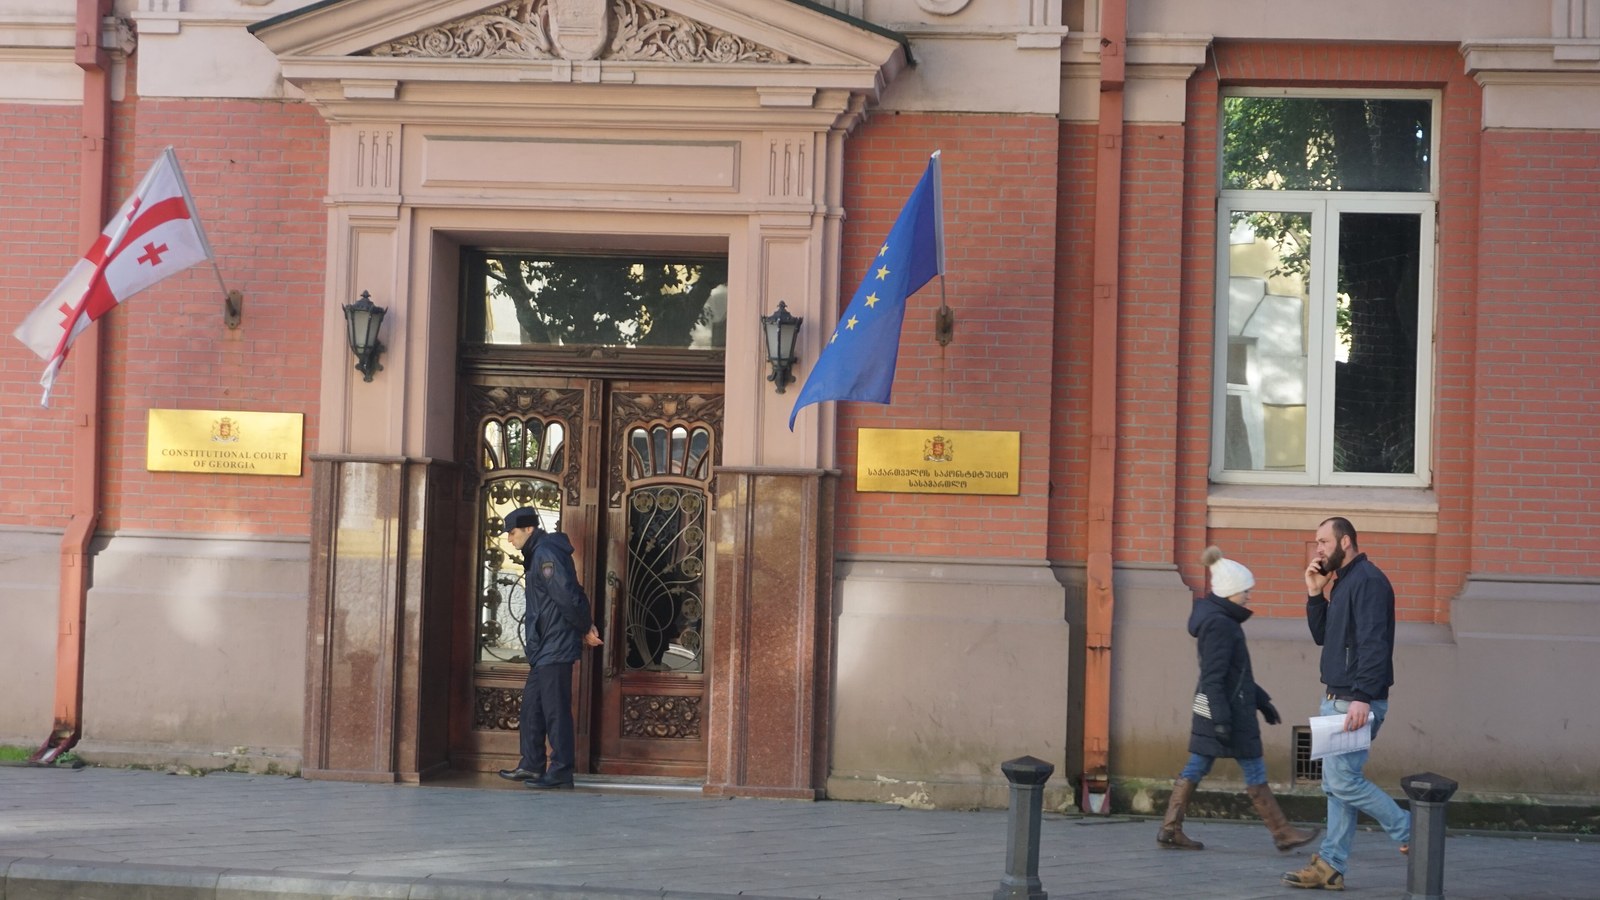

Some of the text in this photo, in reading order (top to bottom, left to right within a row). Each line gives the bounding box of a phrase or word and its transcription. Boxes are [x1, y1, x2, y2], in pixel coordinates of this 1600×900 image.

[161, 448, 288, 460] CONSTITUTIONAL COURT
[193, 460, 255, 469] OF GEORGIA
